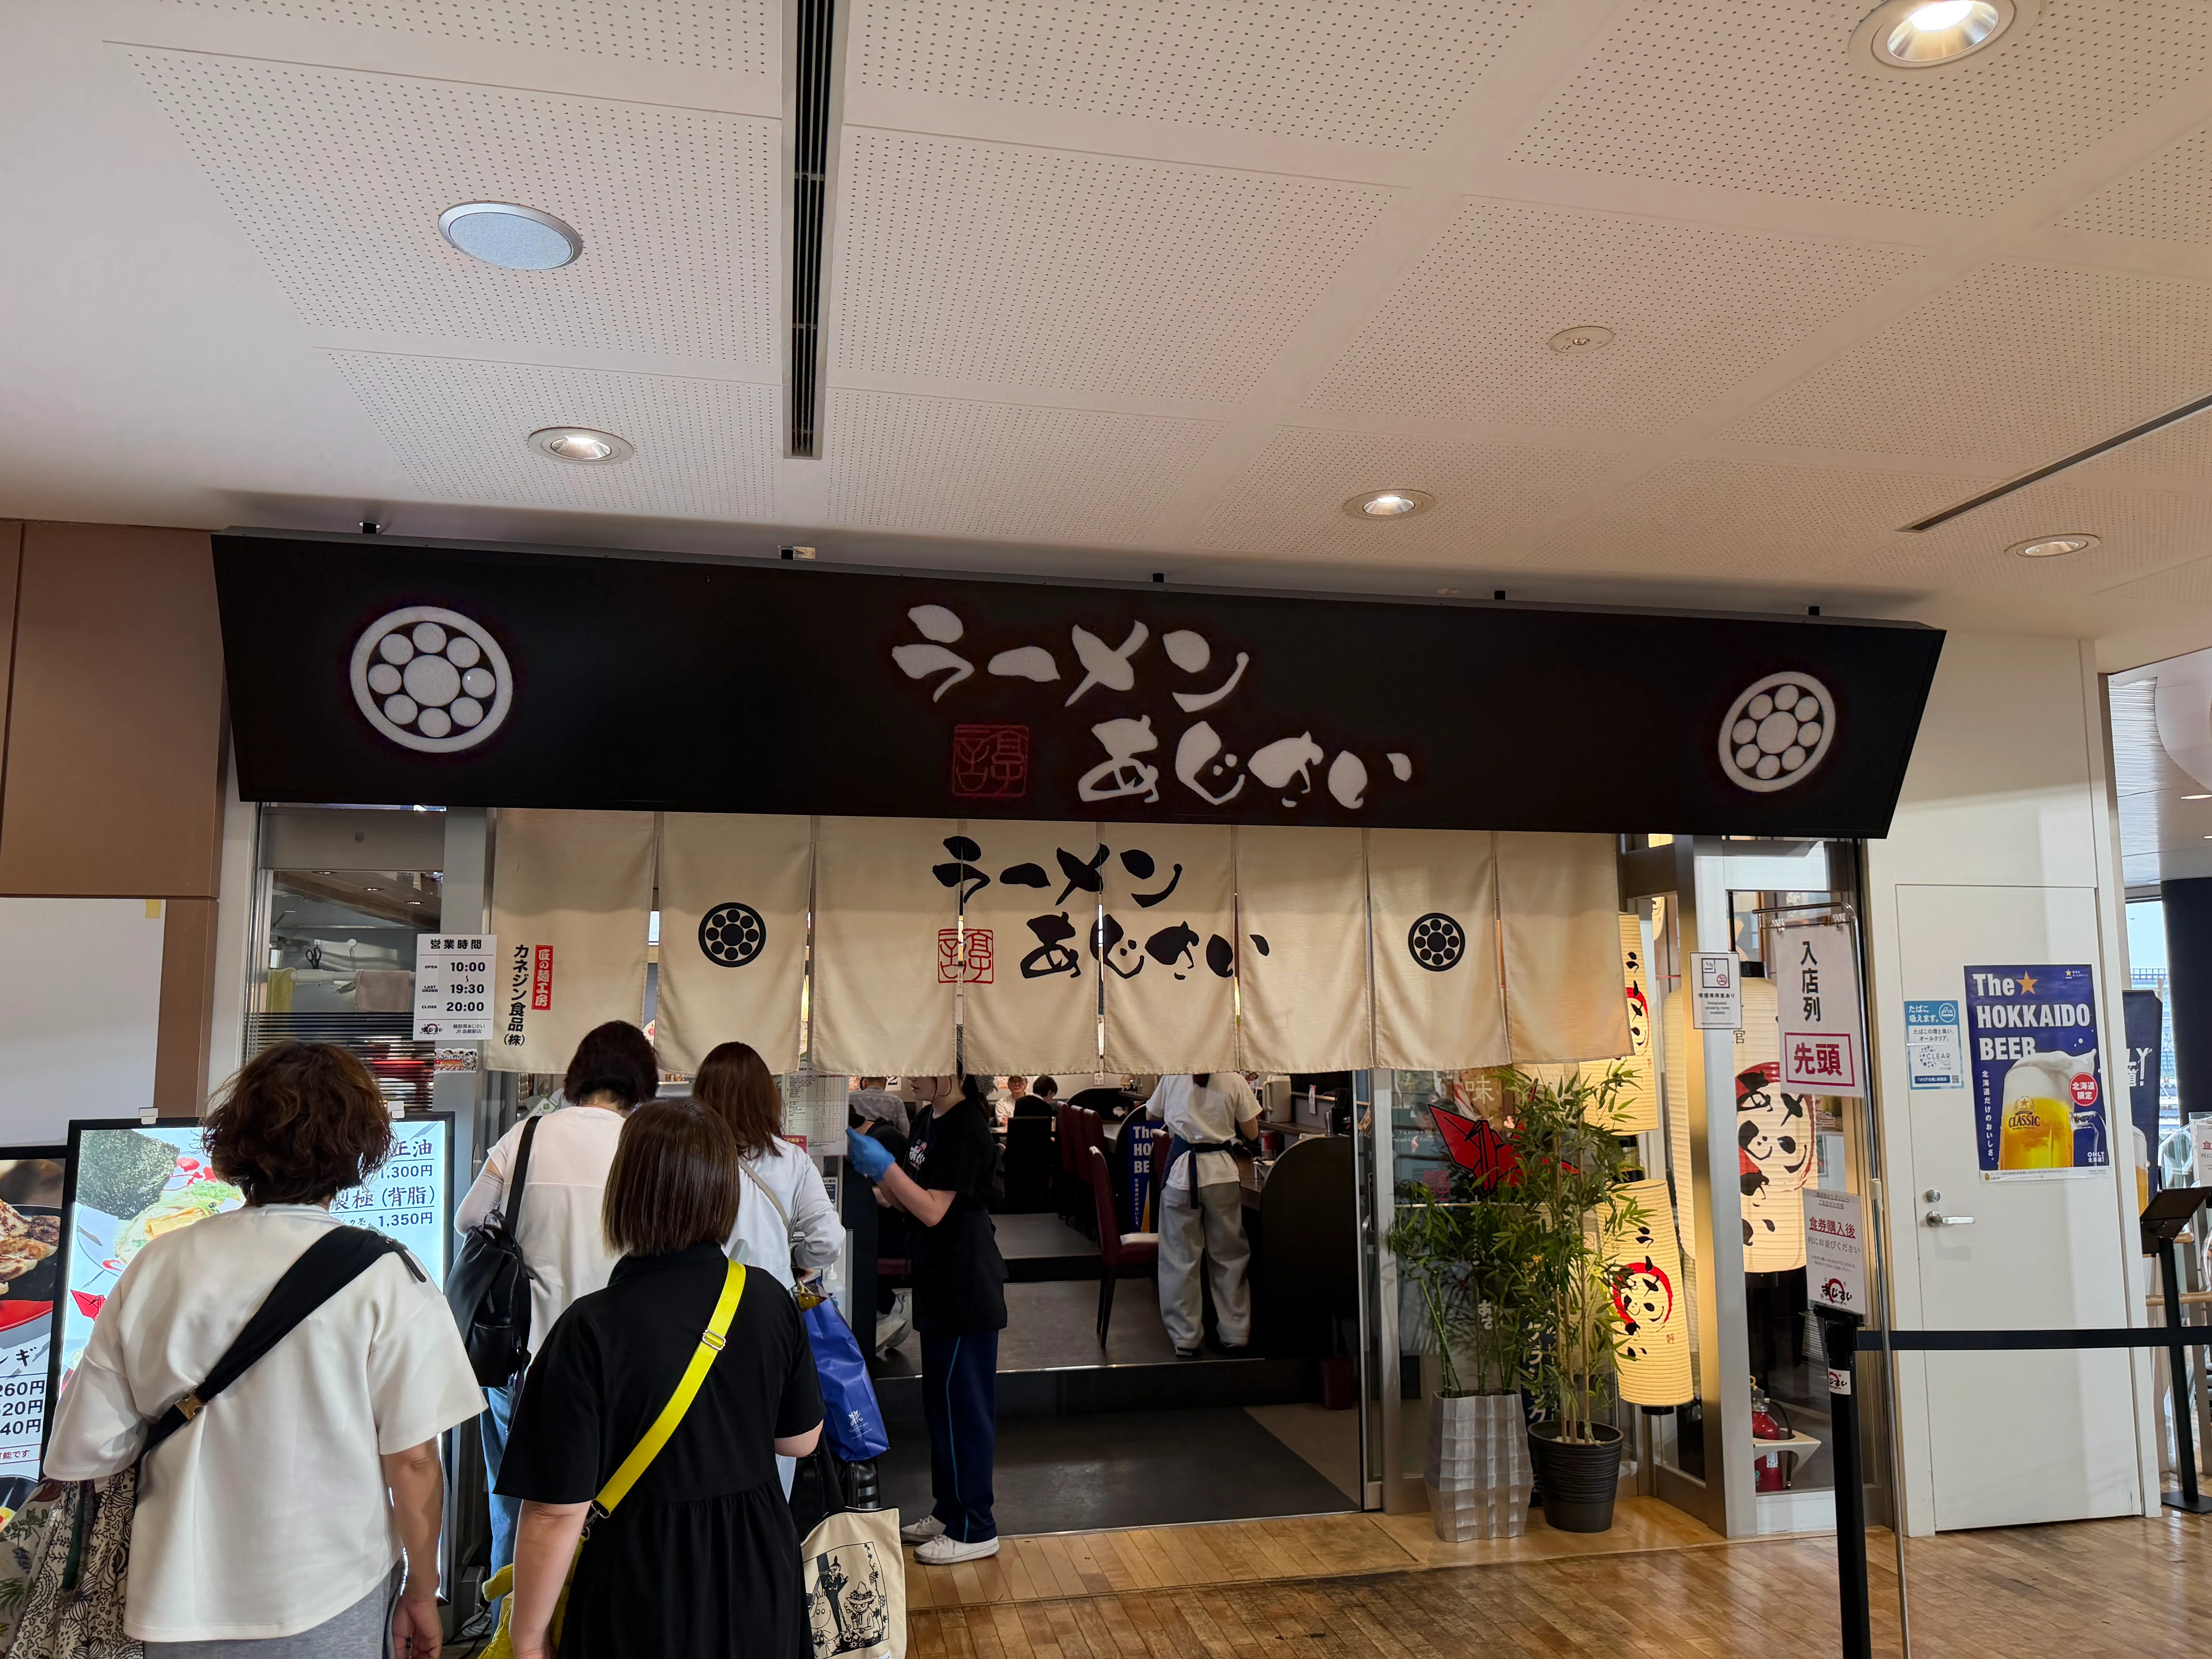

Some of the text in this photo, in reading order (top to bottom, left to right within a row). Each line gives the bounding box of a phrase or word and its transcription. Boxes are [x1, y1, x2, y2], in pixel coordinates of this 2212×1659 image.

[891, 604, 1249, 713] ラーメン
[1079, 715, 1412, 809] あじさい
[932, 836, 1183, 908] ラーメン
[431, 939, 482, 950] 営業時間
[1020, 911, 1269, 979] あじさい
[450, 962, 485, 972] 10:00
[450, 984, 484, 994] 19:30
[1800, 941, 1821, 1022] 入店列
[1972, 974, 2015, 996] The
[447, 1002, 484, 1012] 20:00
[1909, 1005, 1929, 1013] たばこ
[1976, 1003, 2090, 1028] HOKKAIDO
[1909, 1014, 1939, 1023] 吸えます。
[1979, 1037, 2036, 1061] BEER
[1793, 1042, 1843, 1077] 先頭
[1465, 1075, 1495, 1104] 味
[2072, 1081, 2095, 1091] 北海道
[2077, 1091, 2093, 1100] 限定
[1982, 1070, 1994, 1161] 北海道だけのおいしさ。
[2009, 1115, 2040, 1128] CLASSIC
[380, 1164, 433, 1178] 1,300円
[378, 1212, 433, 1227] 1,350円
[1809, 1216, 1856, 1238] 食券購入後
[1807, 1236, 1860, 1254] 列にお並びください
[0, 1399, 43, 1416] 20円
